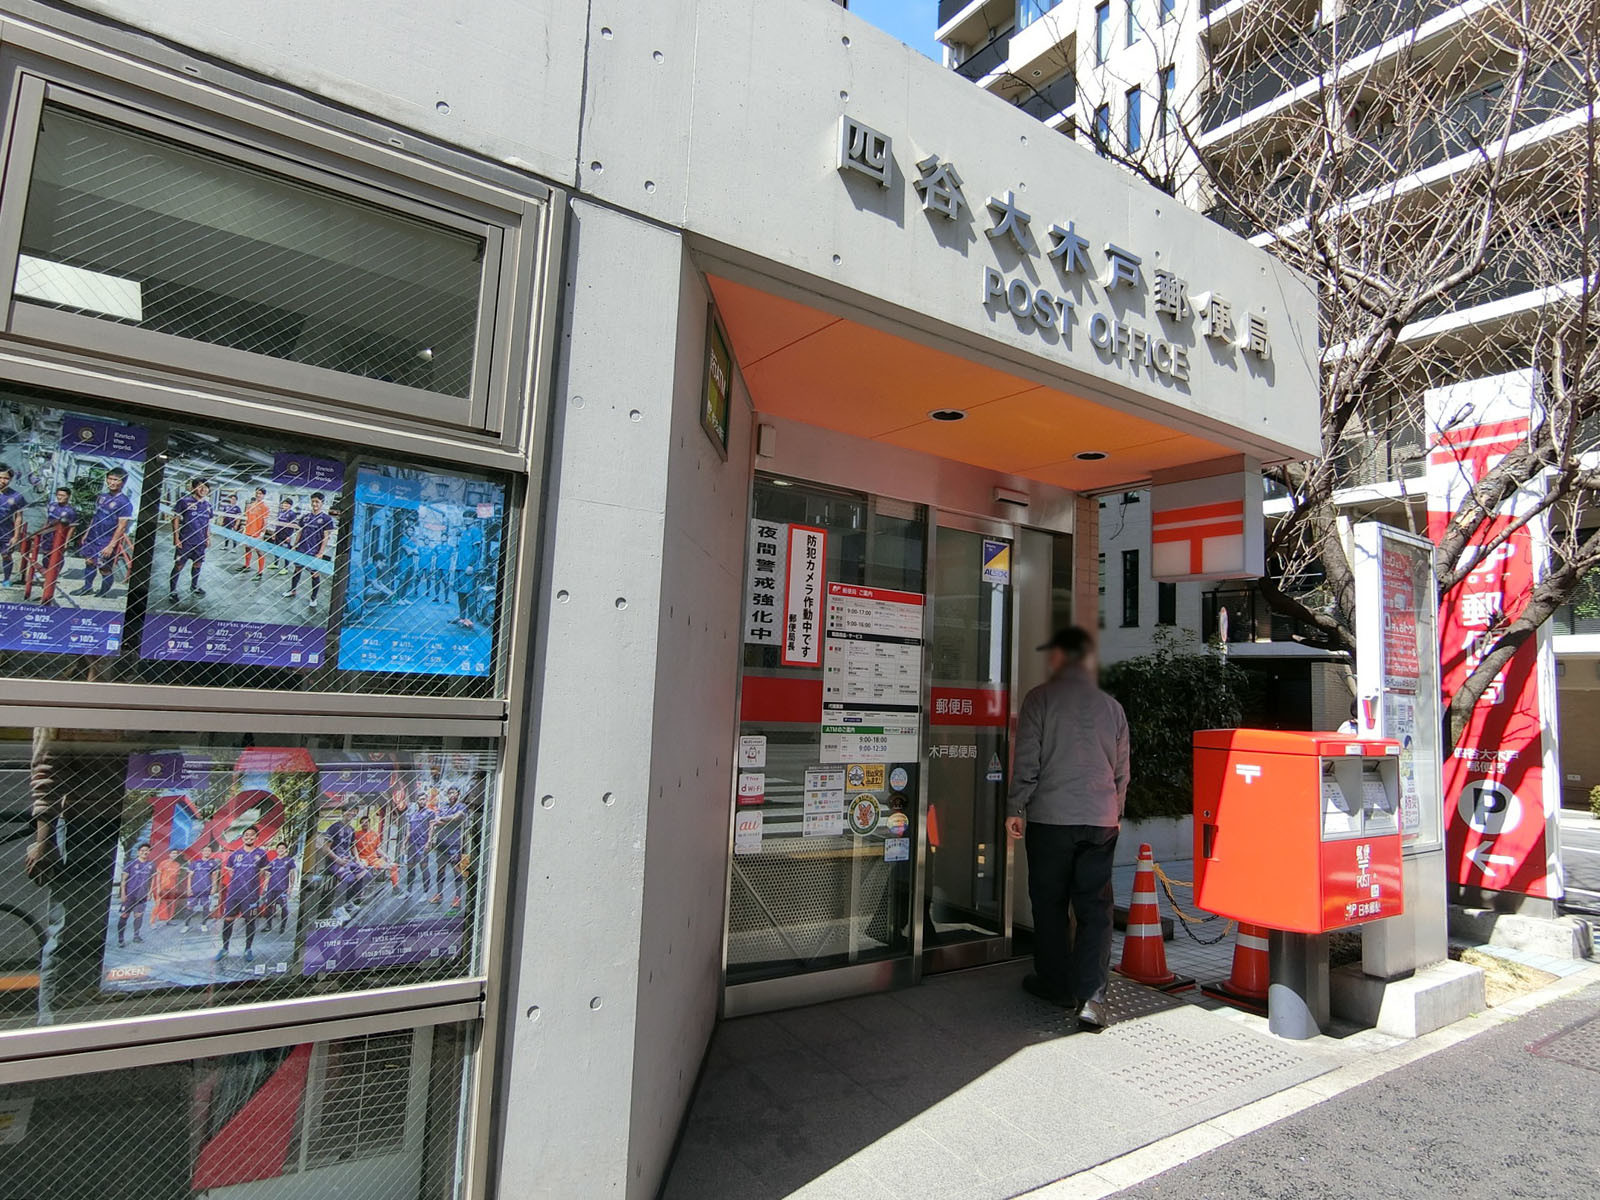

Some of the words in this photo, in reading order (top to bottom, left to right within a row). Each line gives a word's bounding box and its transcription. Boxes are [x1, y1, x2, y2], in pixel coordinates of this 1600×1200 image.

[837, 114, 1272, 361] 四谷大木戸郵便局
[983, 265, 1075, 336] POST
[1090, 312, 1191, 383] OFFICE
[751, 525, 778, 640] 夜間警戒強化中
[801, 535, 817, 658] 防犯カメラ作動中です
[788, 614, 797, 651] 郵便局長
[935, 698, 973, 715] 郵便局
[929, 745, 978, 759] 木戸郵便局
[1473, 788, 1507, 826] P
[739, 820, 760, 831] au
[1356, 874, 1370, 888] POST
[314, 919, 343, 929] TOKEN
[111, 966, 145, 978] TOKEN
